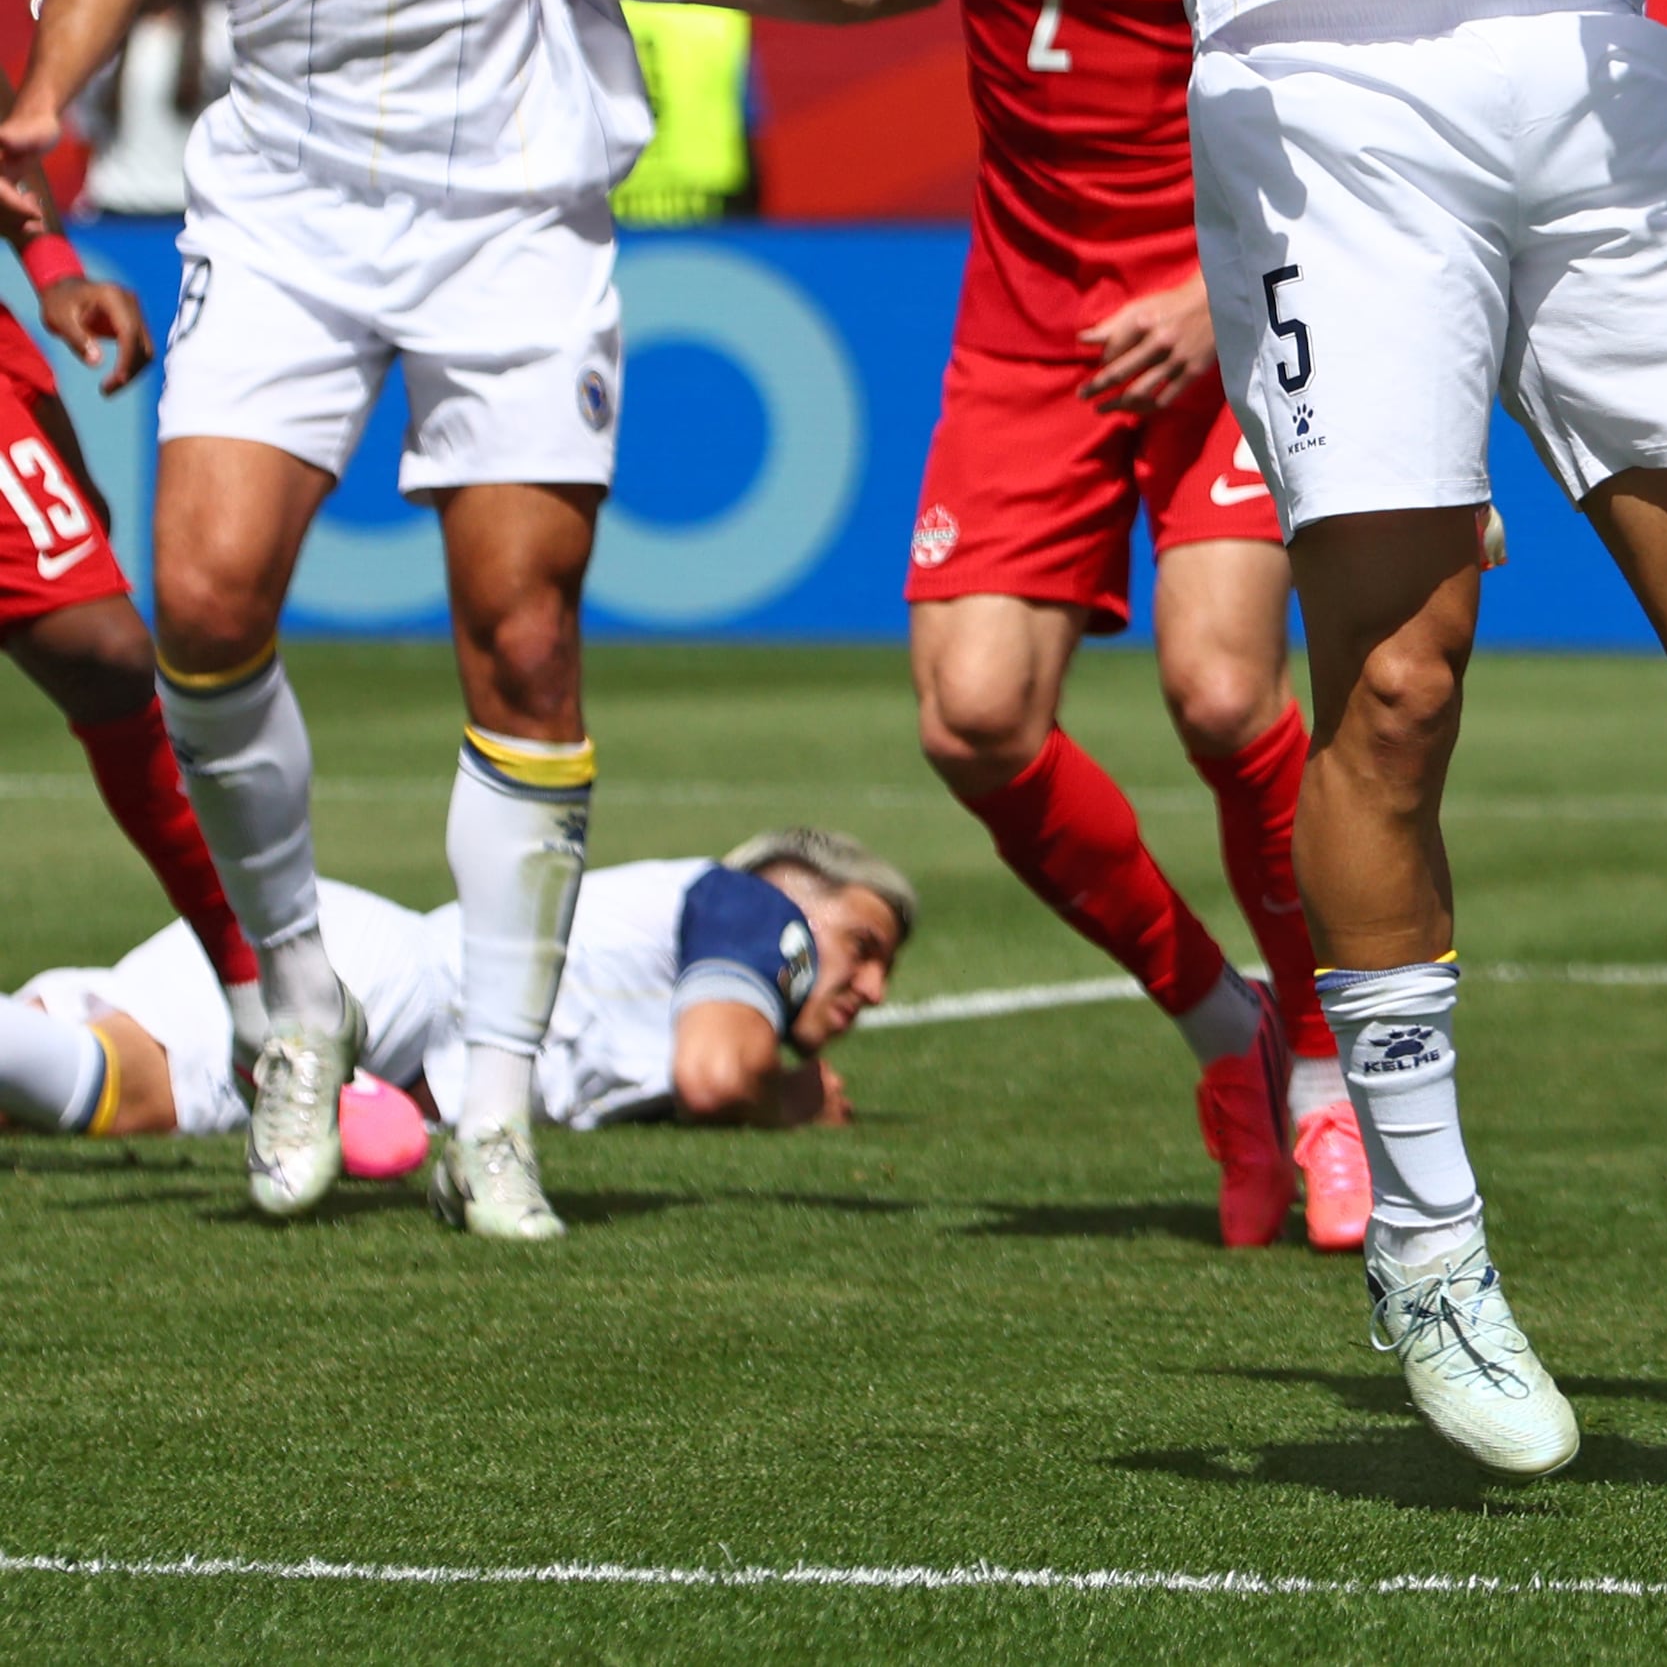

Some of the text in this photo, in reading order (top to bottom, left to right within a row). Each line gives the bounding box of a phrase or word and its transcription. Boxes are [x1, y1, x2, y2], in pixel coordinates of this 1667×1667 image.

[1263, 264, 1318, 397] 5
[1287, 436, 1327, 459] KELME
[0, 437, 93, 549] 13
[1364, 1048, 1440, 1072] KELME
